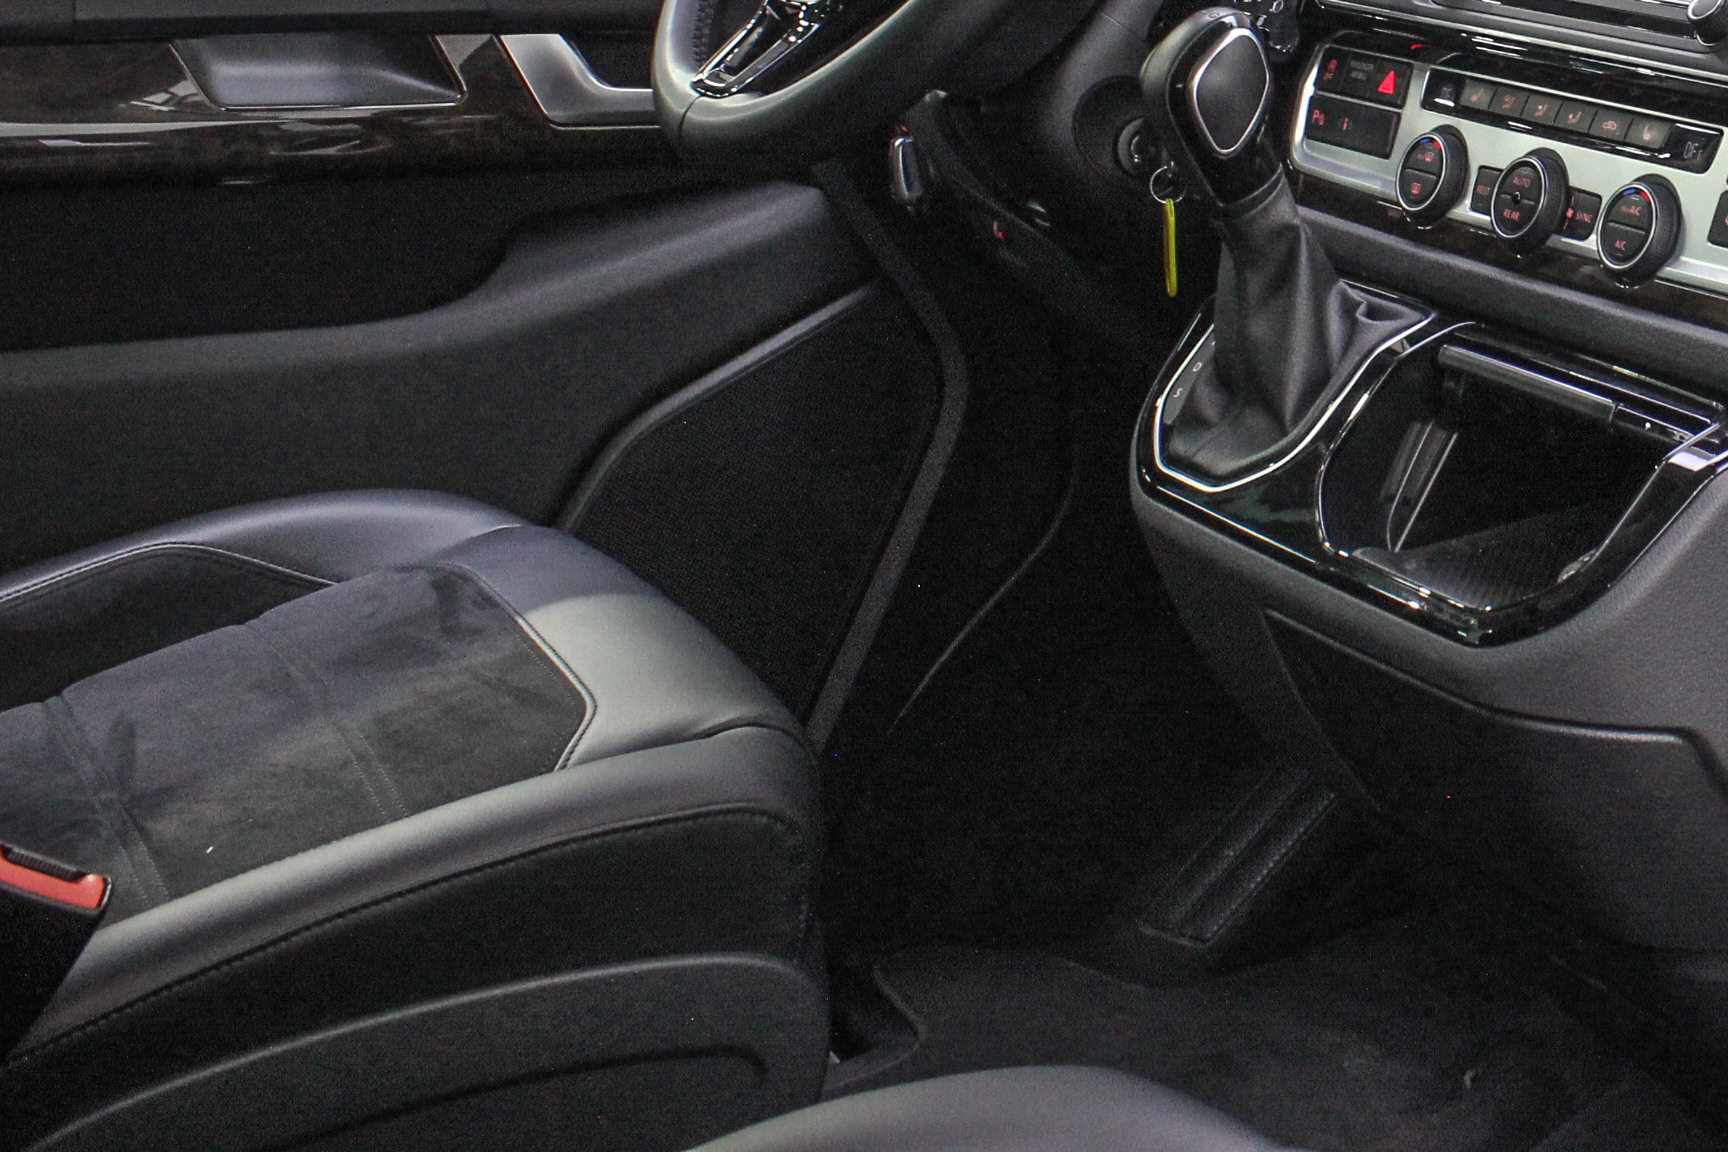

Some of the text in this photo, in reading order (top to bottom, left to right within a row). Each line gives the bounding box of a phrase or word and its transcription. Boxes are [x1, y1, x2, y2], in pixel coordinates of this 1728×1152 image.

[1513, 176, 1531, 188] AUTO
[1503, 209, 1520, 221] REAR
[1576, 211, 1593, 223] SYNC
